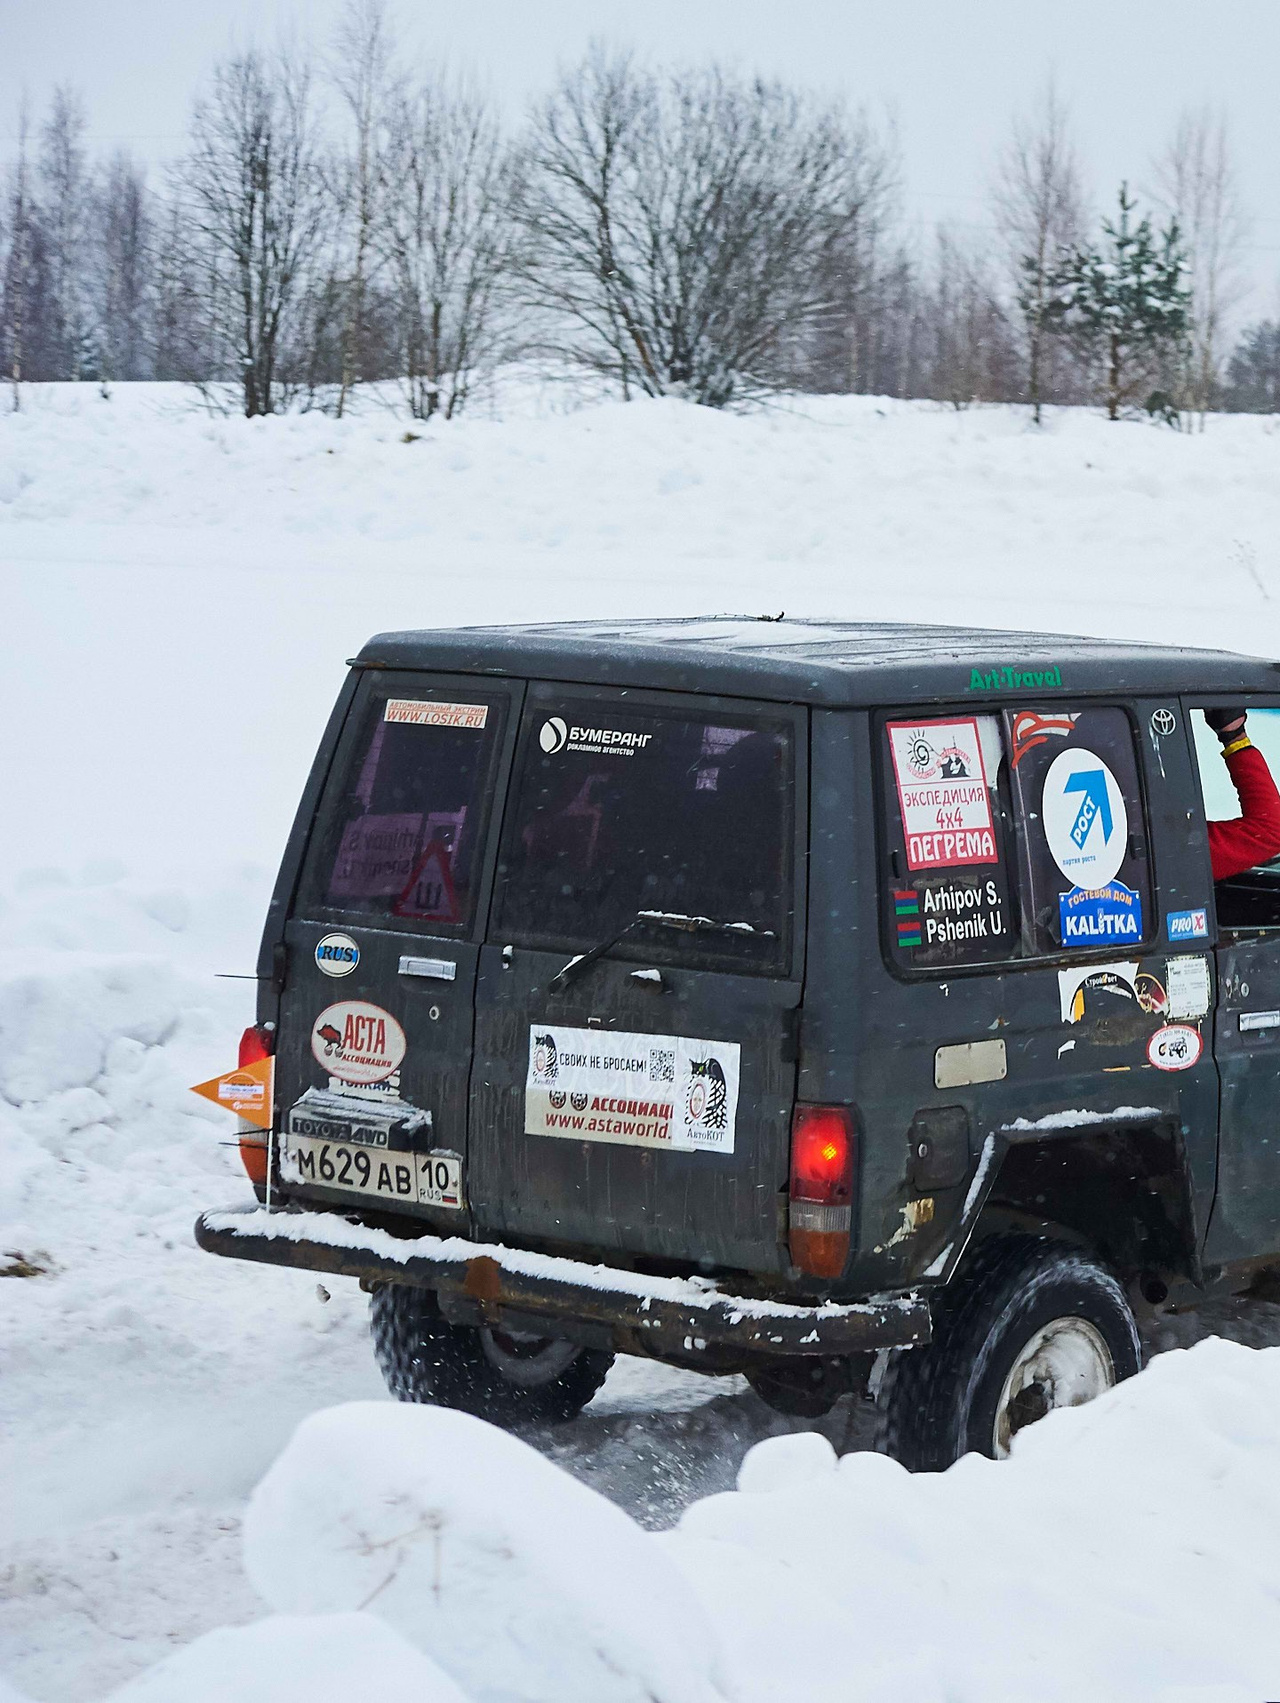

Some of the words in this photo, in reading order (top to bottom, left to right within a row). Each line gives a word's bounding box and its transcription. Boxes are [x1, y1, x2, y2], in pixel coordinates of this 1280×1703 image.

[388, 710, 484, 727] WWW.LOSIK.RU
[569, 727, 652, 747] БУМЕРАНГ
[567, 743, 601, 753] рекламное
[602, 746, 634, 756] агентство
[905, 788, 984, 807] ЭКСПЕДИЦИЯ
[1073, 796, 1096, 843] РОСТ
[910, 831, 994, 863] ПЕГРЕМА
[1063, 856, 1081, 866] партия
[1082, 855, 1096, 864] роста
[924, 885, 982, 915] Arhipov
[986, 881, 1001, 905] S.
[1068, 889, 1112, 908] ГОСТЕВОЙ
[1113, 891, 1132, 906] ДОМ
[926, 913, 987, 943] Pshenik
[990, 910, 1006, 935] U.
[1066, 912, 1138, 936] KALITKA
[322, 945, 354, 962] RUS
[342, 1014, 386, 1054] АСТА
[341, 1055, 392, 1068] АССОЦИАЦИЯ
[559, 1052, 587, 1068] СВОИХ
[590, 1055, 600, 1068] НЕ
[603, 1056, 647, 1073] БРОСАЕМ!
[591, 1097, 674, 1119] АССОЦИАЦ
[296, 1119, 350, 1140] TOYOTA
[351, 1127, 387, 1146] 4WD
[686, 1128, 725, 1142] АвтоКОТ
[422, 1160, 448, 1190] 10
[420, 1188, 441, 1200] RUS
